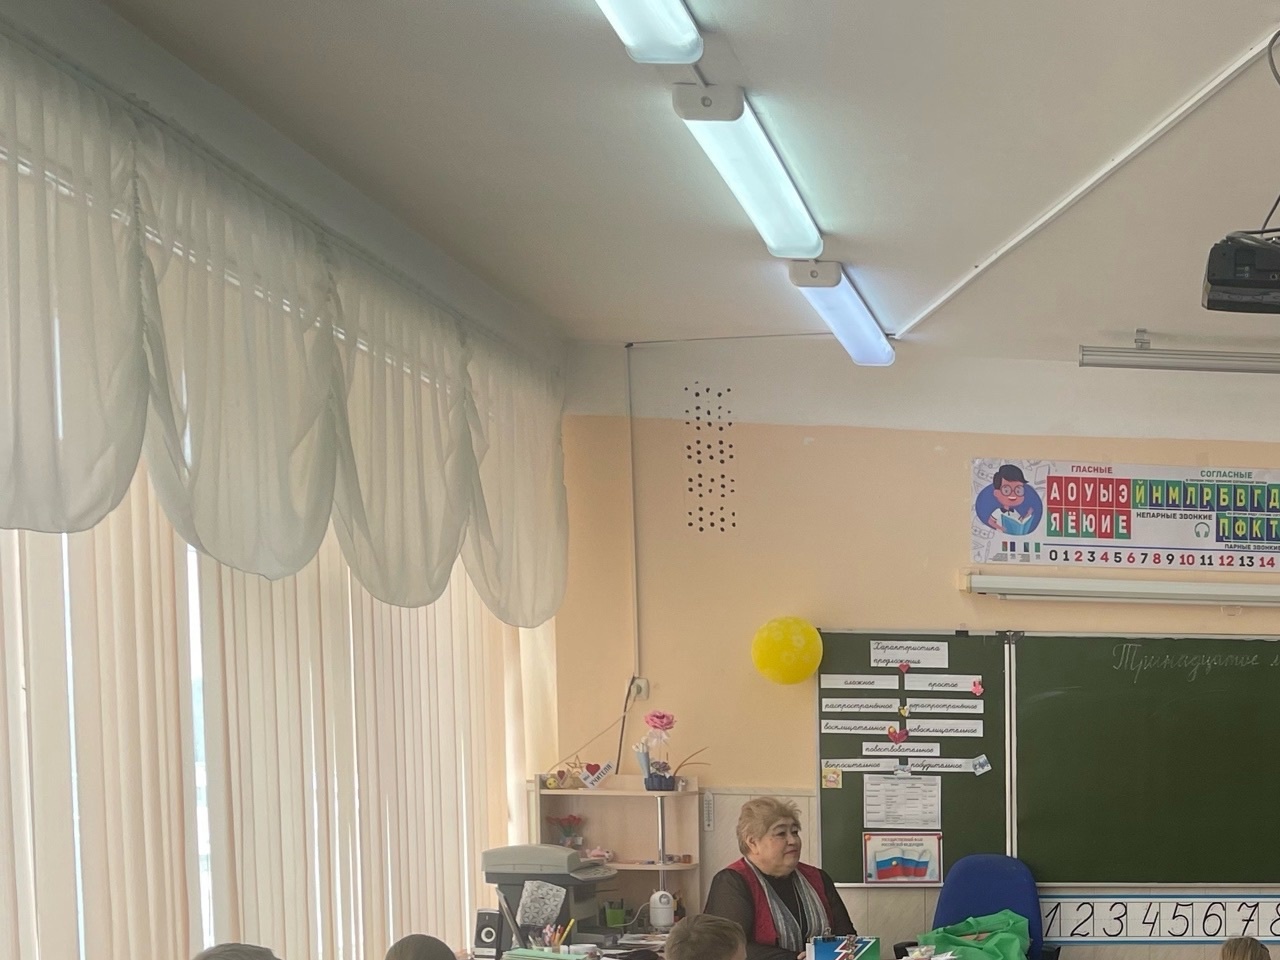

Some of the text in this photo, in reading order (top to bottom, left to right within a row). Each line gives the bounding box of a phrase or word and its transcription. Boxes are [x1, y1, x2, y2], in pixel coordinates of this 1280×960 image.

[1071, 465, 1113, 474] ГЛАСНЫЕ
[1200, 470, 1253, 479] СОГЛАСНЫЕ
[1050, 482, 1060, 500] А
[1067, 482, 1076, 501] О
[1084, 483, 1094, 501] У
[1100, 484, 1112, 502] Ы
[1118, 484, 1128, 503] Э
[1135, 480, 1145, 504] Й
[1153, 486, 1162, 504] Н
[1169, 486, 1179, 505] М
[1186, 487, 1195, 505] Л
[1203, 487, 1211, 505] Р
[1219, 488, 1229, 506] Б
[1236, 488, 1246, 507] В
[1254, 489, 1262, 507] Г
[1269, 489, 1279, 509] Д
[1050, 512, 1127, 534] Я Ё Ю И Е
[1136, 512, 1213, 521] НЕПАРНЫЕ ЗВОНКИЕ
[1219, 518, 1229, 537] П
[1235, 519, 1246, 538] Ф
[1252, 519, 1261, 538] К
[1269, 520, 1278, 538] Т
[1049, 550, 1058, 561] 0
[1063, 550, 1070, 561] 1
[1074, 550, 1083, 561] 2
[1087, 550, 1095, 562] 3
[1100, 551, 1109, 562] 4
[1114, 551, 1122, 563] 5
[1127, 552, 1136, 563] 6
[1141, 553, 1148, 563] 7
[1153, 553, 1161, 564] 8
[1166, 553, 1175, 564] 9
[1180, 553, 1195, 565] 10
[1200, 554, 1214, 566] 11
[1219, 555, 1234, 566] 12
[1239, 555, 1254, 567] 13
[1259, 556, 1275, 568] 14
[873, 641, 940, 654] Характеристика
[928, 682, 958, 690] простое
[589, 764, 612, 786] УЧИТЕЛЯ
[1044, 902, 1062, 937] 1
[1070, 902, 1094, 937] 2
[1103, 902, 1127, 937] 3
[1142, 902, 1160, 937] 4
[1168, 902, 1193, 937] 5
[1202, 902, 1225, 937] 6
[1237, 902, 1259, 937] 7
